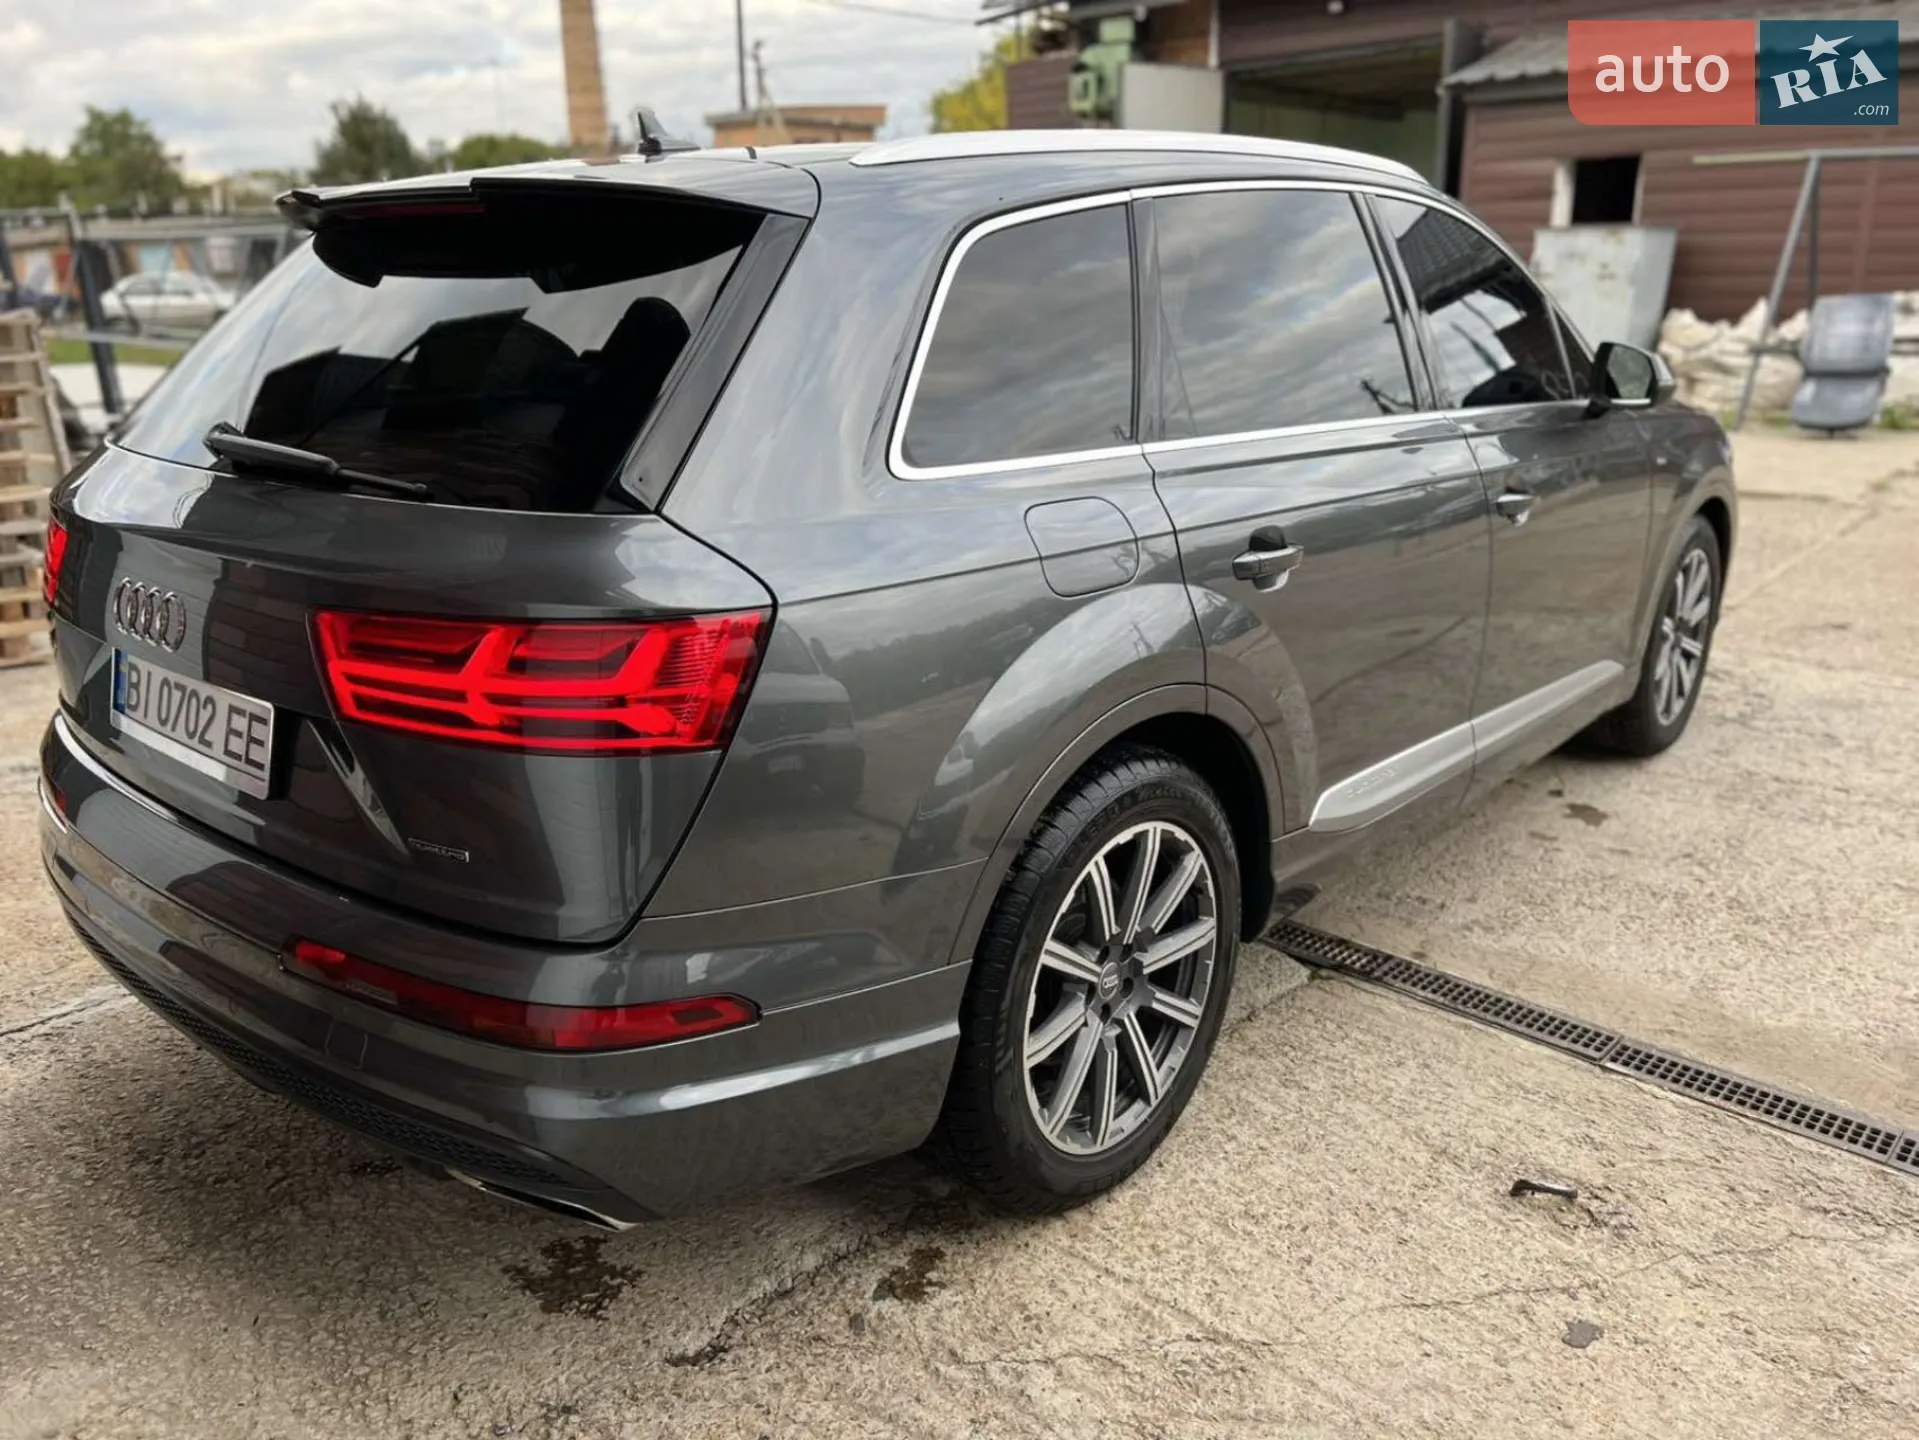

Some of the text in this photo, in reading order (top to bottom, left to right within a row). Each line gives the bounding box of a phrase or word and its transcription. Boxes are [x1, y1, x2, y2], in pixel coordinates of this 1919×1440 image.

[127, 661, 268, 772] BI 0702 EE
